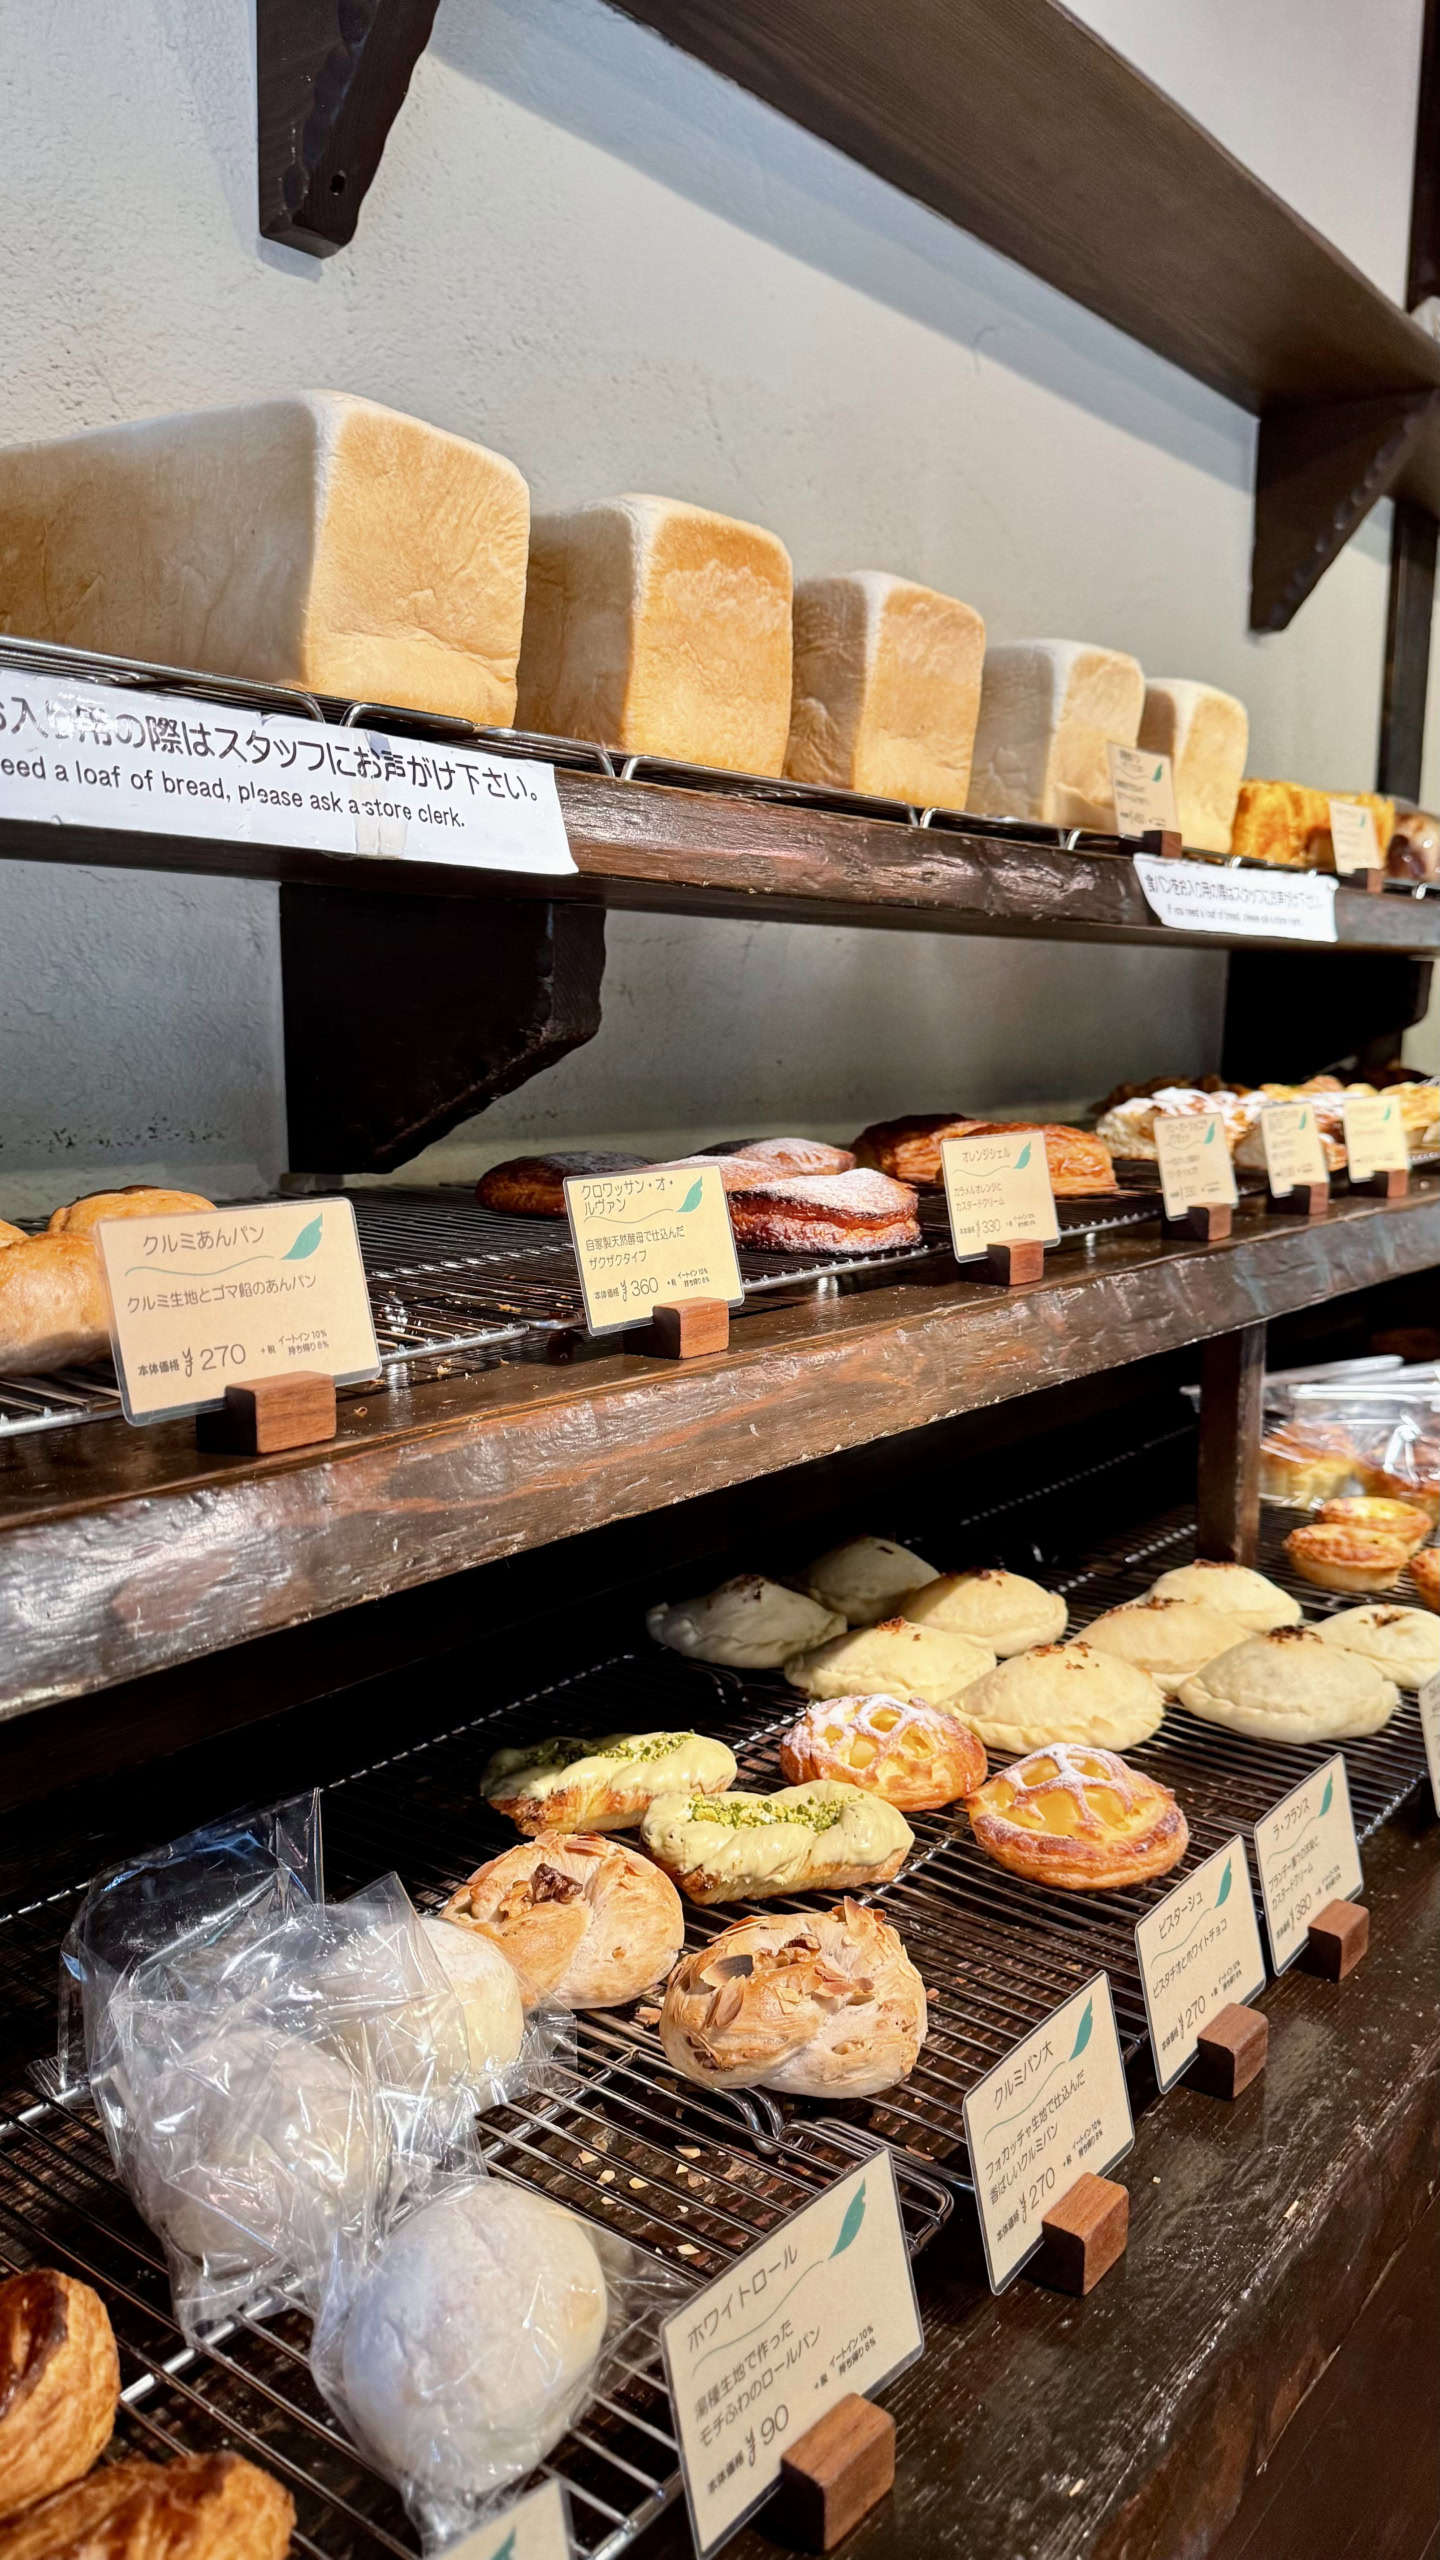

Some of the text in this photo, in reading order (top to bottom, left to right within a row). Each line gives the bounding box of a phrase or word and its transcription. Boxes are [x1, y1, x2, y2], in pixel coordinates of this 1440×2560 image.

[55, 764, 69, 782] a
[76, 760, 120, 788] loaf
[130, 769, 154, 792] of
[163, 772, 231, 805] bread,
[239, 783, 303, 811] please
[309, 789, 344, 814] ask
[348, 801, 360, 816] a
[365, 800, 413, 822] store
[418, 801, 466, 828] clerk.
[962, 1147, 1011, 1163] オレンジシェル
[581, 1177, 673, 1200] クロワッサン・オ・
[584, 1199, 626, 1217] ルヴァン
[143, 1226, 264, 1256] クルミあんパン
[586, 1225, 685, 1251] 自家製天然酵母で仕込んだ
[589, 1250, 647, 1271] ザクザクタイプ
[127, 1275, 316, 1313] クルミ生地とゴマ餡のあんパン
[278, 1329, 327, 1345] イートイン 10%
[138, 1359, 180, 1377] 本体価格
[182, 1343, 246, 1378] ¥270
[1272, 1797, 1311, 1841] ラ・フランス
[994, 2041, 1054, 2111] クルミパン大
[986, 2069, 1085, 2181] フォカッチャ生地で仕込んだ
[989, 2122, 1058, 2205] 香ばしいクルミパン
[688, 2245, 797, 2352] ホワイトロール
[829, 2337, 858, 2367] イートイン
[700, 2326, 820, 2447] モチふわのロールパン
